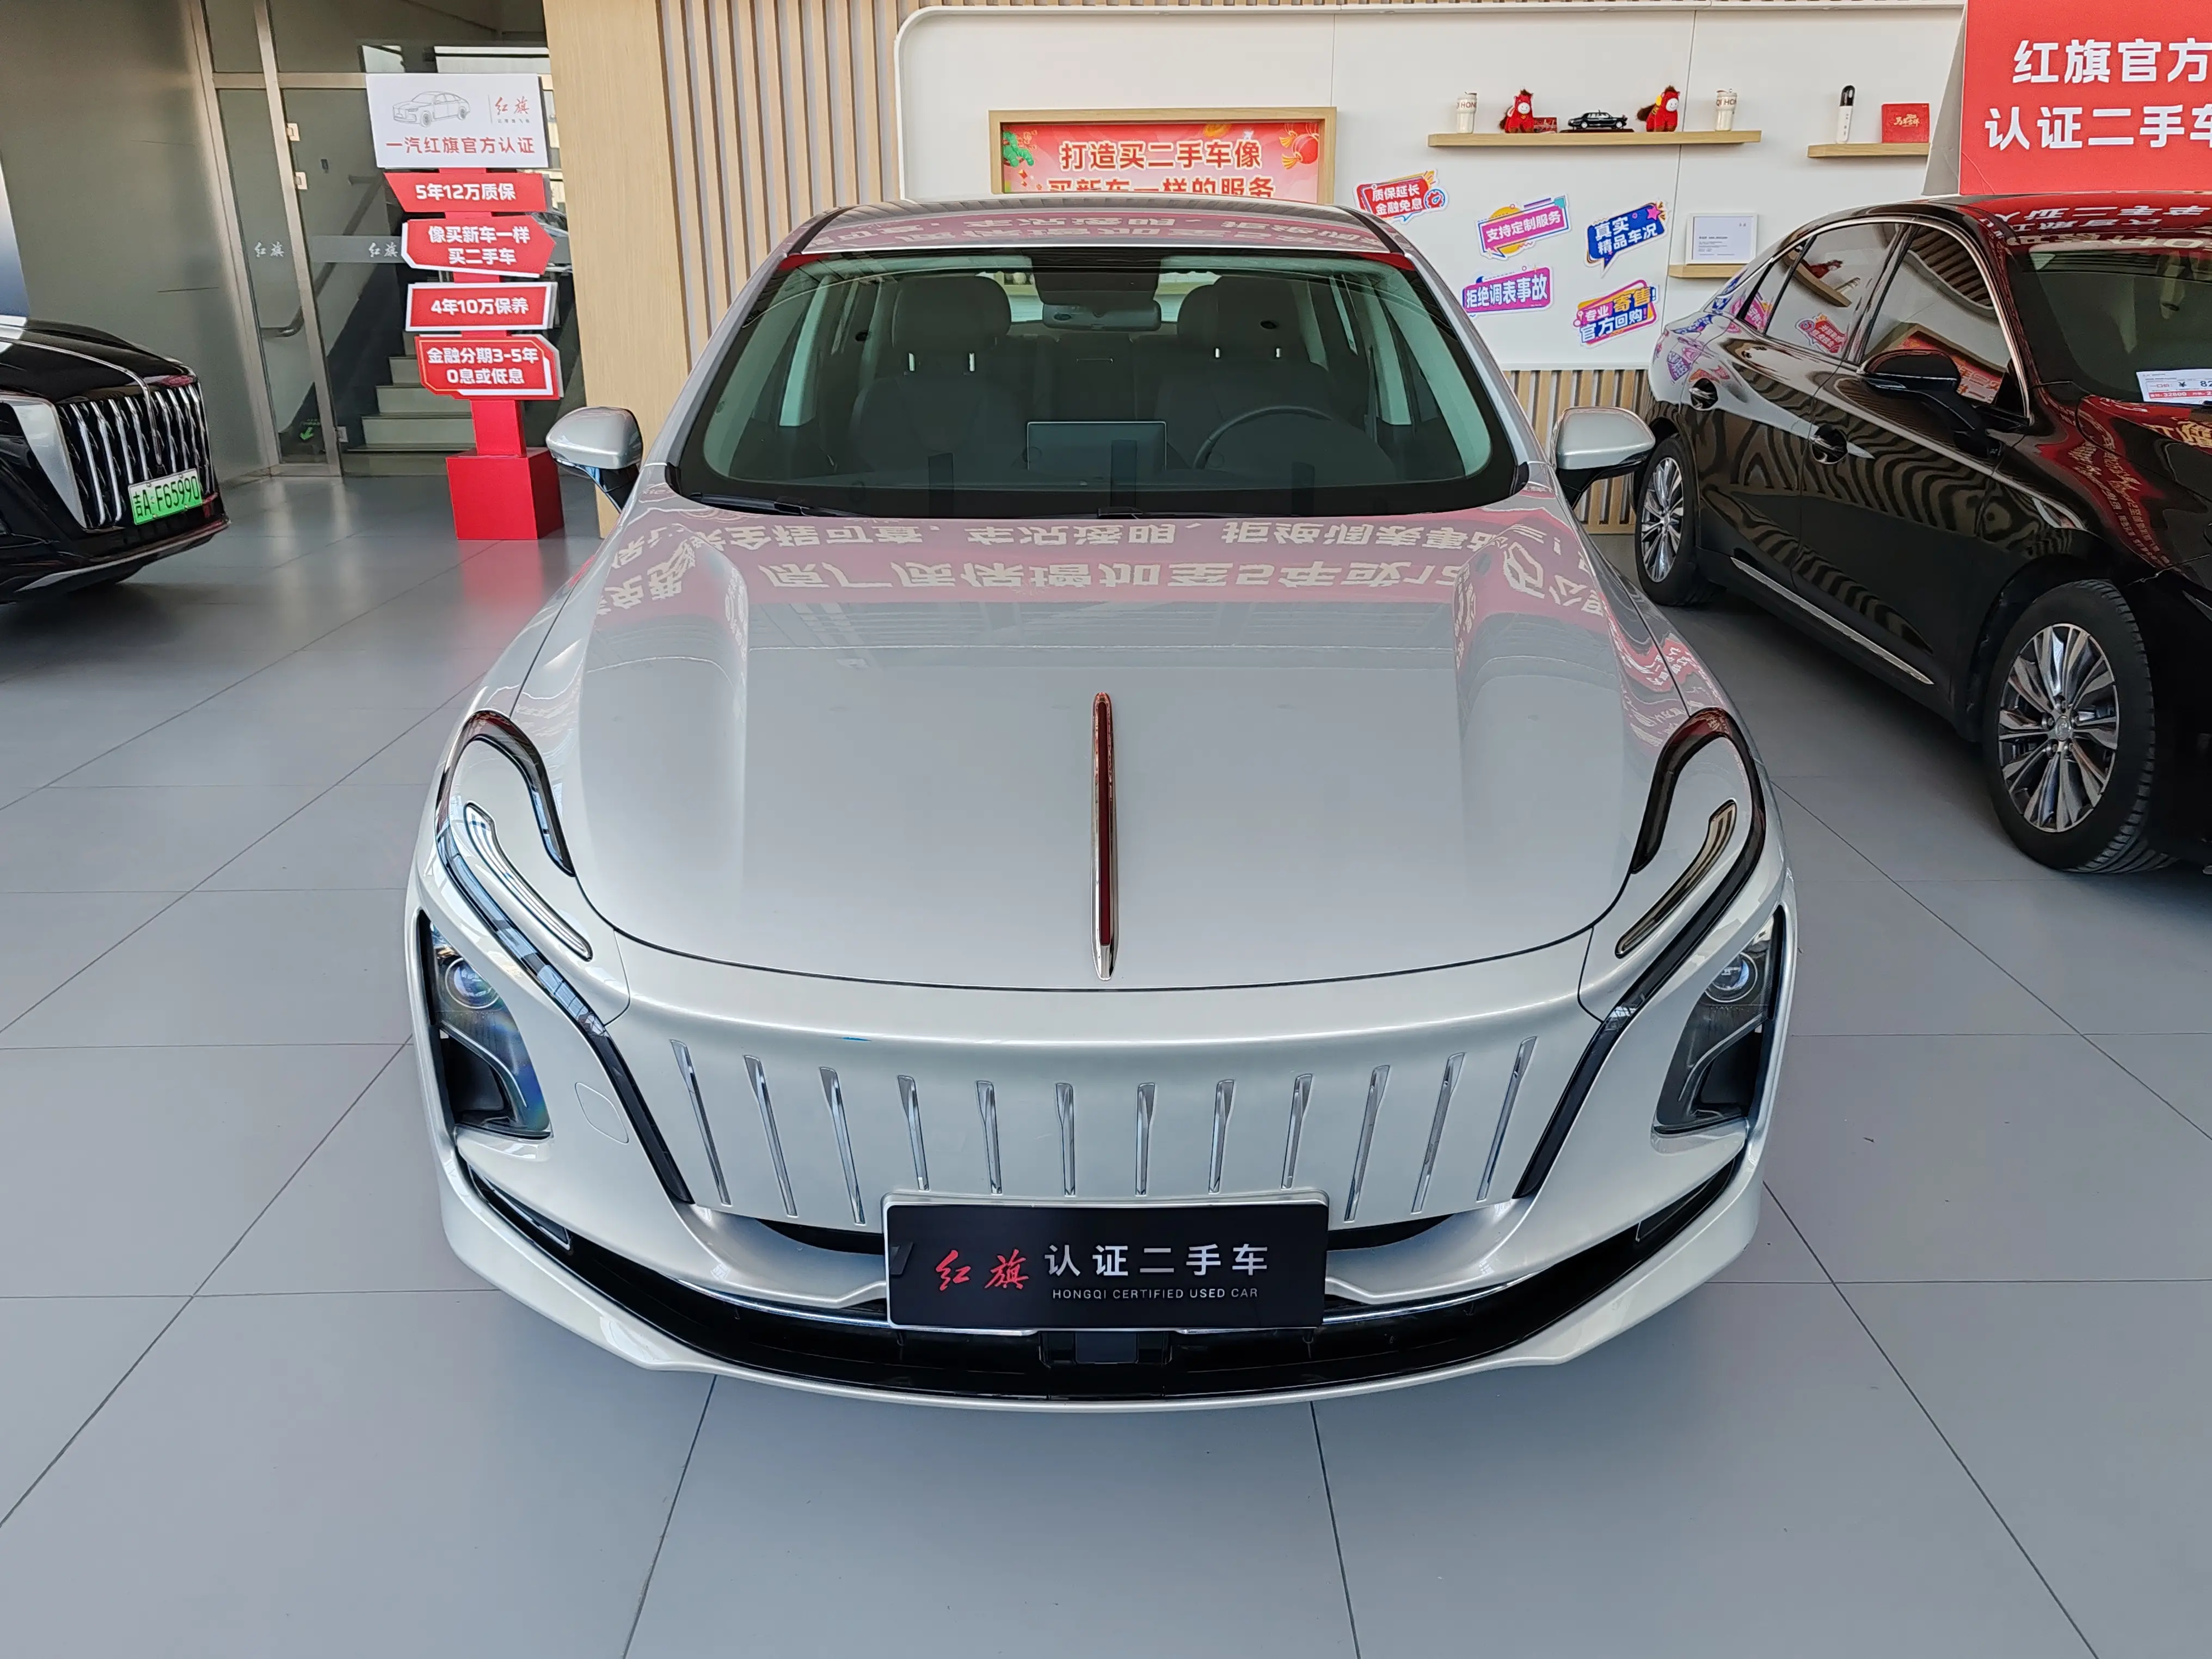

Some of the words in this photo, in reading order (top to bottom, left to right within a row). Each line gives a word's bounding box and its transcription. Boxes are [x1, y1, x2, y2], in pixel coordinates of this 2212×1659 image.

[2013, 38, 2212, 84] 红旗官方
[495, 96, 530, 115] 红旗
[386, 137, 534, 153] 一汽红旗官方认证
[1060, 140, 1262, 169] 打造买二手车像
[415, 183, 517, 201] 5年12万质保
[1372, 184, 1420, 201] 质保延长
[1375, 198, 1423, 215] 金融免息
[428, 226, 530, 243] 像买新车一样
[1486, 211, 1561, 242] 支持定制服务
[1594, 216, 1629, 241] 真实
[1597, 223, 1658, 255] 精品车况
[254, 241, 284, 257] 红旗
[368, 242, 399, 257] 红旗
[448, 248, 517, 265] 买二手车
[1466, 273, 1547, 308] 拒绝调表事故
[431, 298, 529, 316] 4年10万保养
[426, 347, 539, 364] 金融分期3-5年
[446, 368, 524, 384] 0息或低息
[935, 1249, 1030, 1292] 红旗
[1044, 1243, 1268, 1276] 认证二手车
[1052, 1288, 1107, 1300] HONGQI
[1113, 1288, 1184, 1299] CERTIFIED
[1189, 1288, 1225, 1299] USED
[1231, 1288, 1258, 1299] CAR
